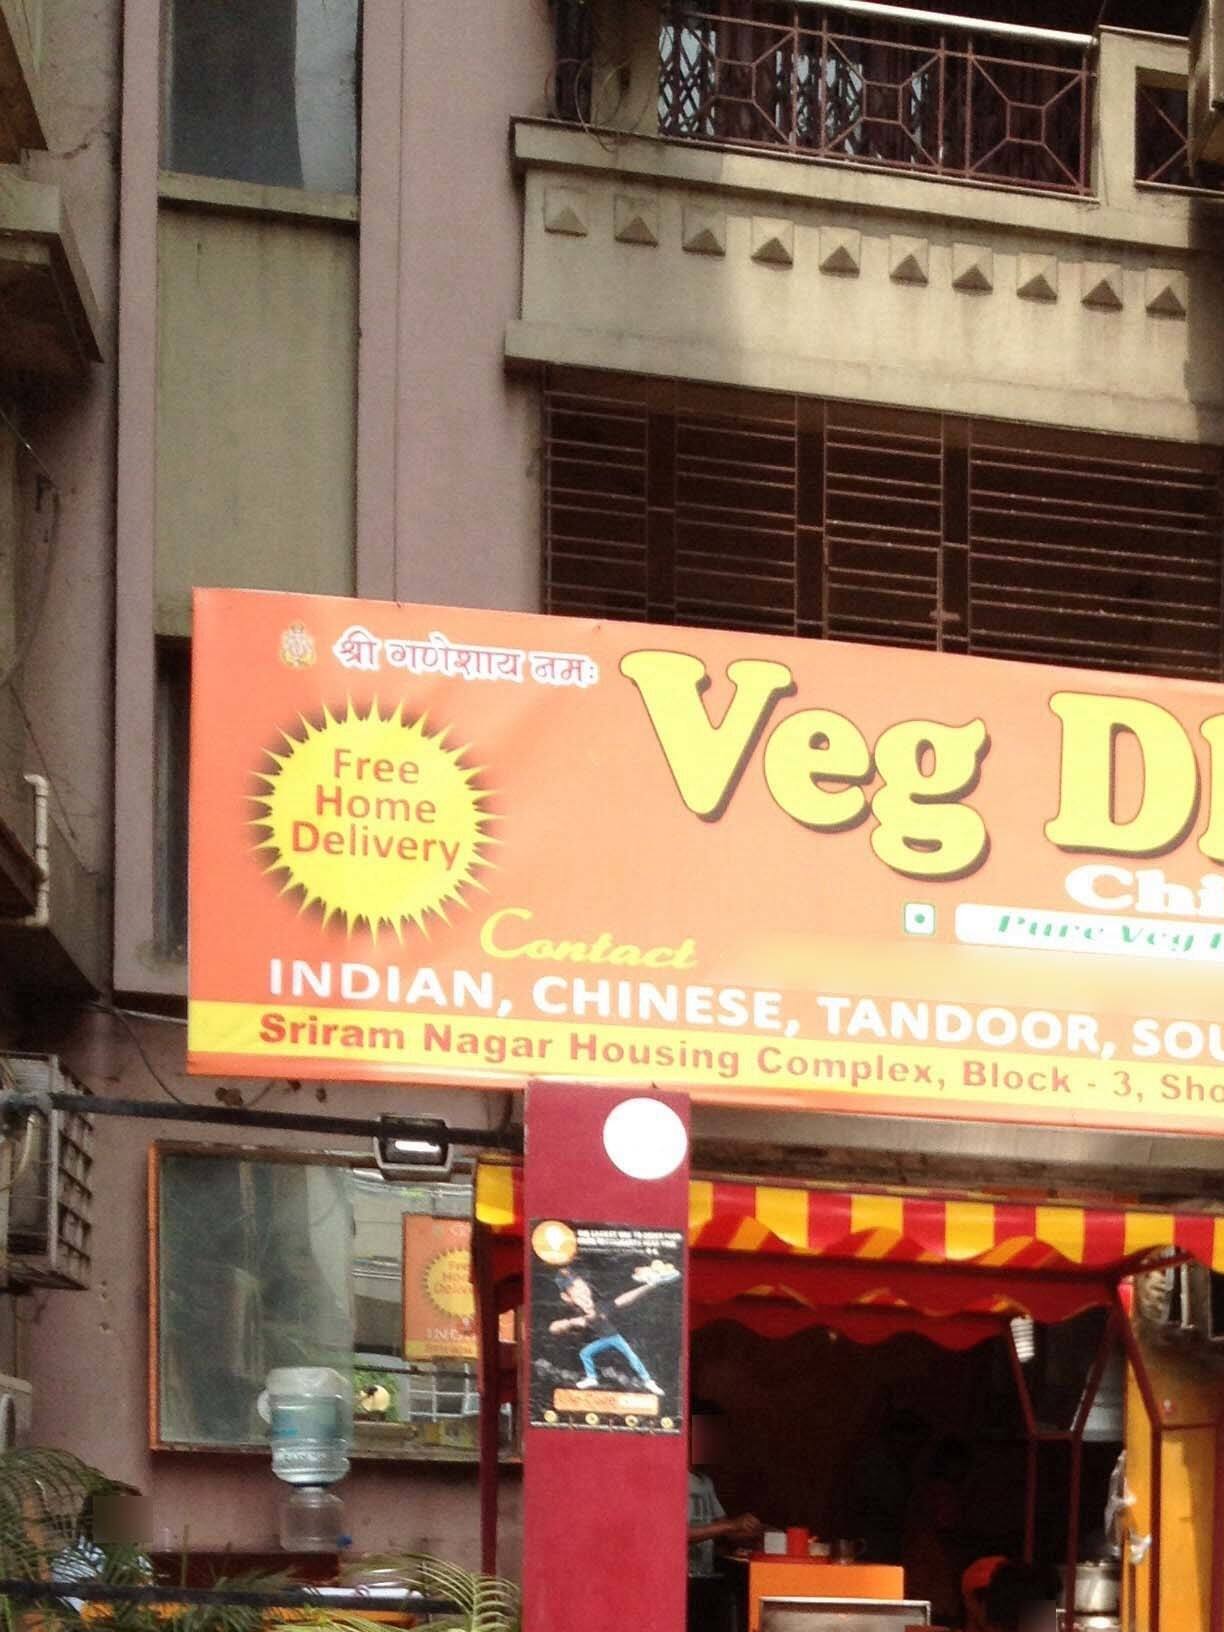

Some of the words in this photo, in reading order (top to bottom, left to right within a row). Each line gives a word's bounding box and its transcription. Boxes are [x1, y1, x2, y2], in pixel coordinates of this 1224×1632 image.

[339, 629, 377, 665] श्री
[388, 635, 521, 677] गणेशाय
[533, 655, 595, 681] नमः
[333, 747, 420, 784] Free
[619, 648, 990, 882] Veg
[314, 784, 437, 824] Home
[291, 820, 460, 871] Delivery
[480, 907, 698, 969] Contact
[997, 914, 1105, 940] Pure
[1122, 924, 1195, 953] Veg
[268, 957, 513, 1018] INDIAN,
[531, 974, 799, 1038] CHINESE,
[816, 996, 1117, 1060] TANDOOR,
[258, 1011, 405, 1050] Sriram
[423, 1022, 553, 1064] Nagar
[569, 1032, 739, 1079] Housing
[756, 1045, 945, 1090] Complex,
[962, 1059, 1072, 1093] Block
[1112, 1070, 1145, 1103] 3,
